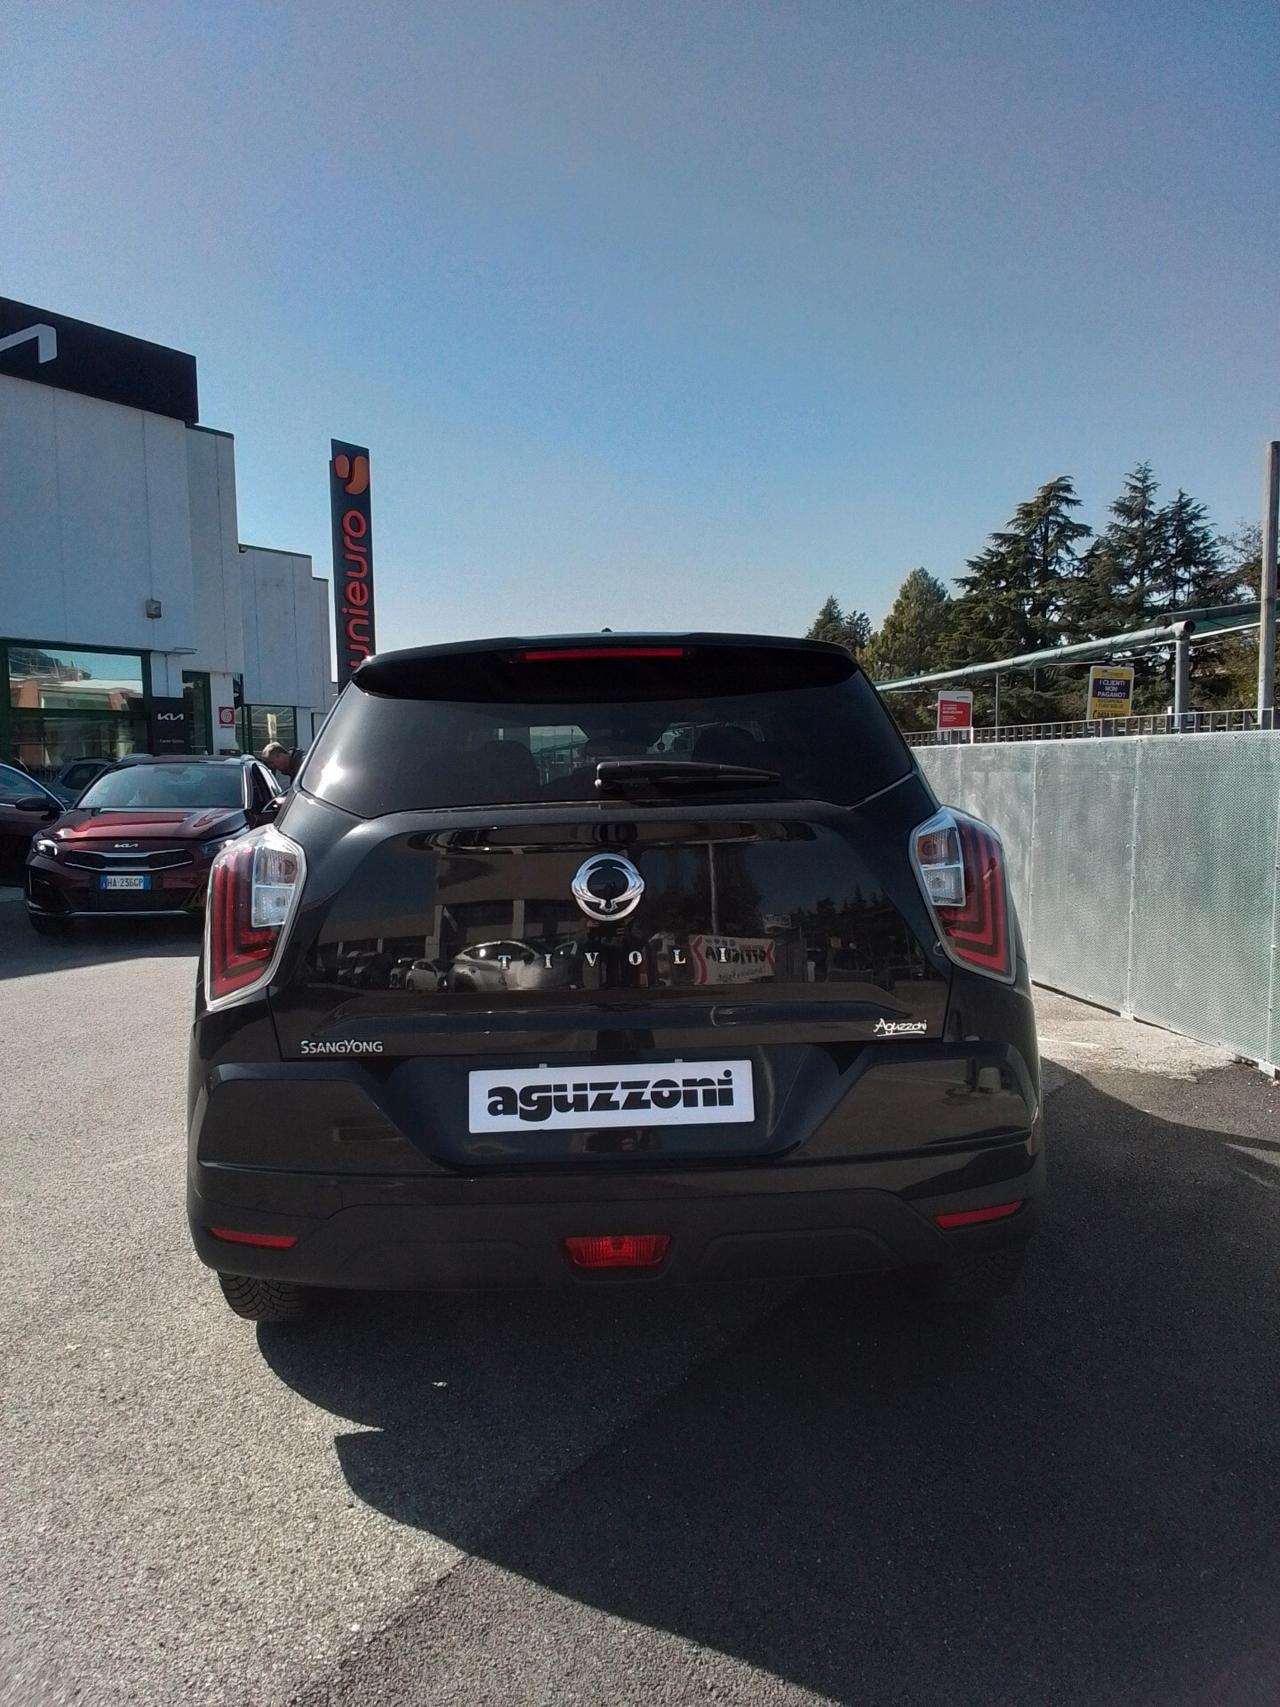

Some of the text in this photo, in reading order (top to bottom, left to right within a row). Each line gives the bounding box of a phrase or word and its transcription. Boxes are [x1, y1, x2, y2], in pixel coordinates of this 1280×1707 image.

[342, 509, 370, 668] unieuro
[498, 947, 727, 971] TIVOLI
[487, 1069, 734, 1122] aguzzoni
